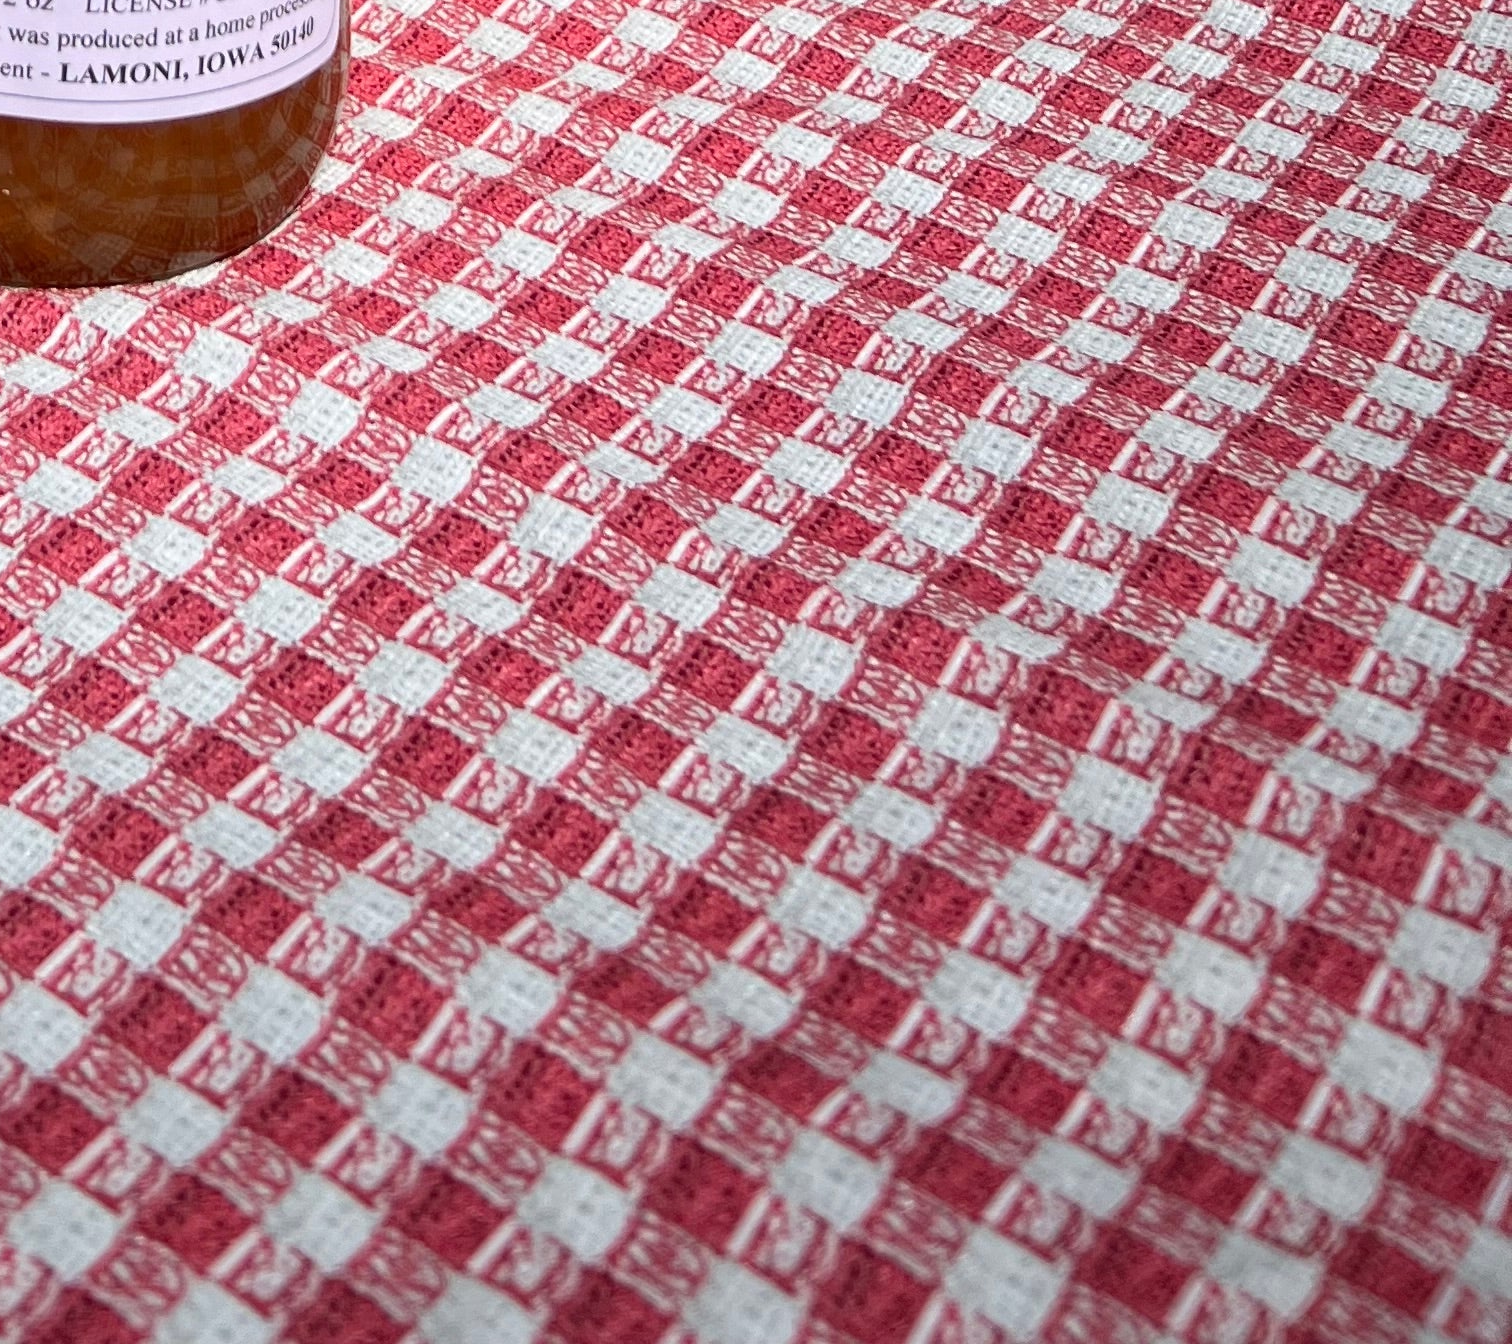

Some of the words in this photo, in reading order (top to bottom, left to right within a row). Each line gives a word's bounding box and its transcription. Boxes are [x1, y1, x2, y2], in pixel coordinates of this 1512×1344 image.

[8, 26, 50, 47] was
[57, 27, 159, 52] produced
[164, 28, 184, 46] at
[188, 26, 200, 43] a
[205, 19, 256, 41] home
[58, 58, 190, 85] LAMONI,
[197, 40, 266, 77] IOWA
[270, 15, 315, 57] 50140
